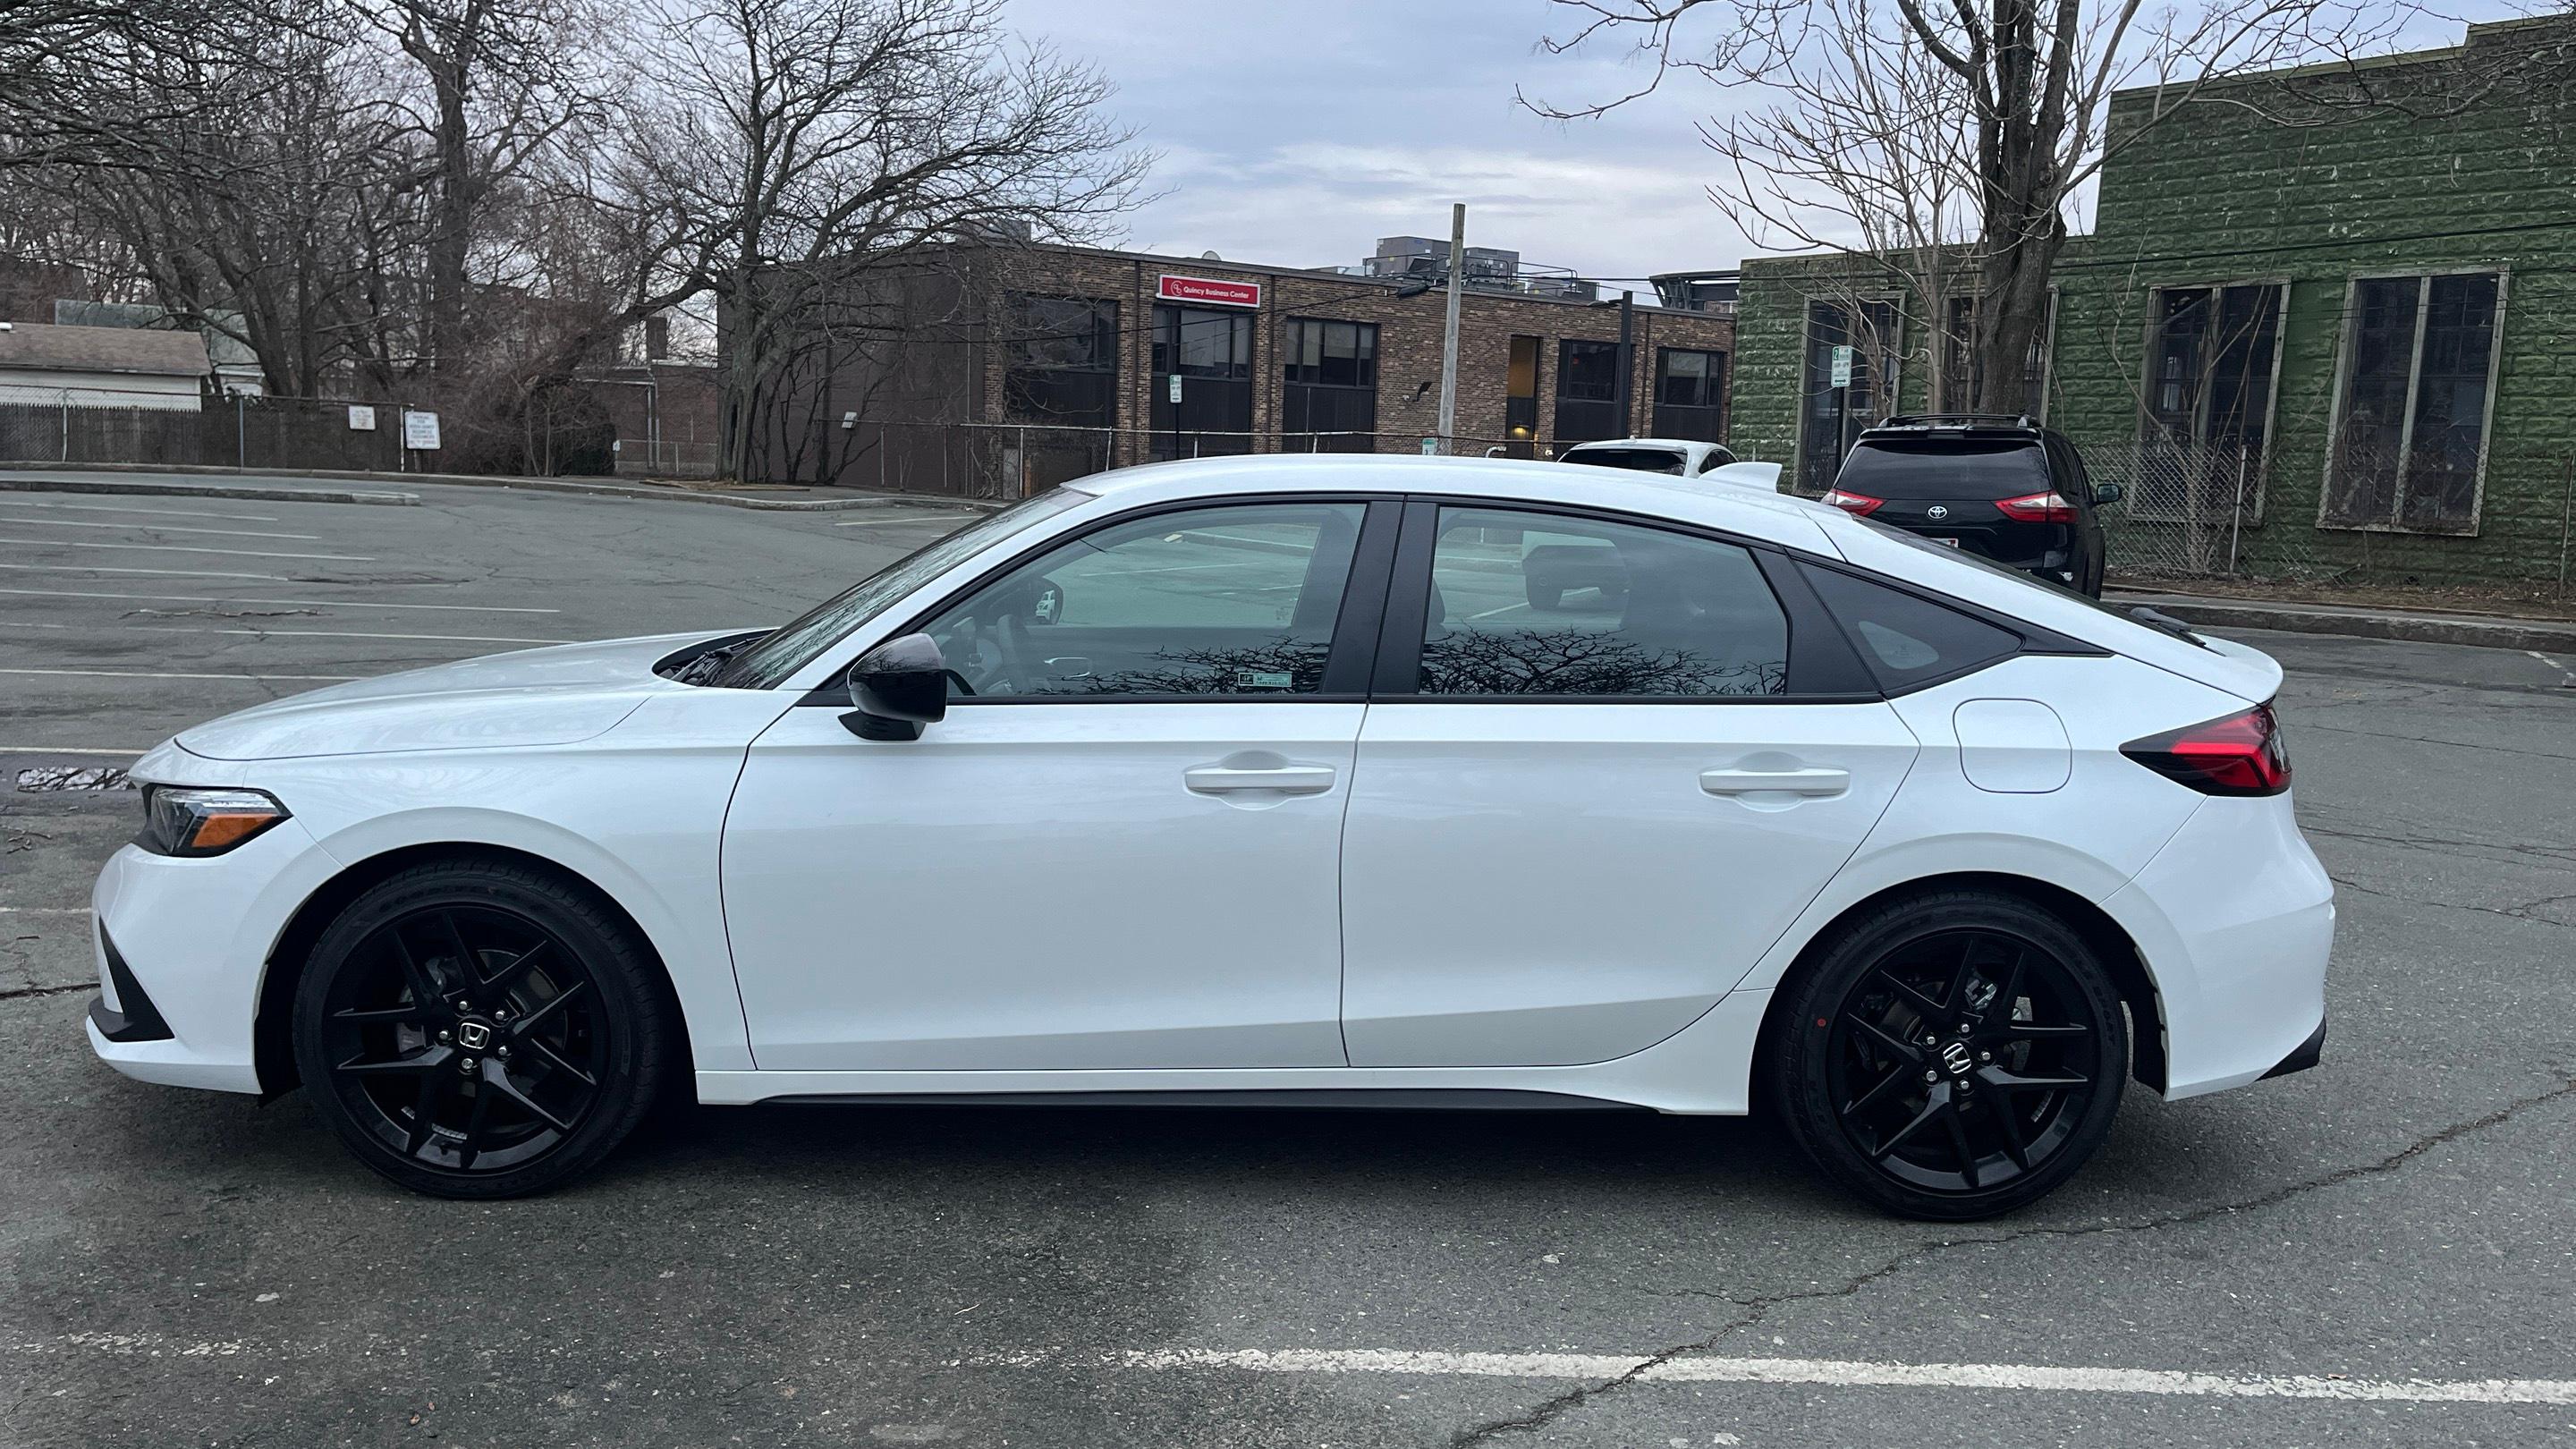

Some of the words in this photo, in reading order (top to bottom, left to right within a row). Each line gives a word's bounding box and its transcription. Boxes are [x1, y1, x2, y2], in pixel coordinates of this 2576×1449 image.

[1183, 286, 1205, 296] Quincy
[1205, 288, 1229, 297] Business
[1230, 291, 1250, 299] Center
[1834, 349, 1839, 360] 2
